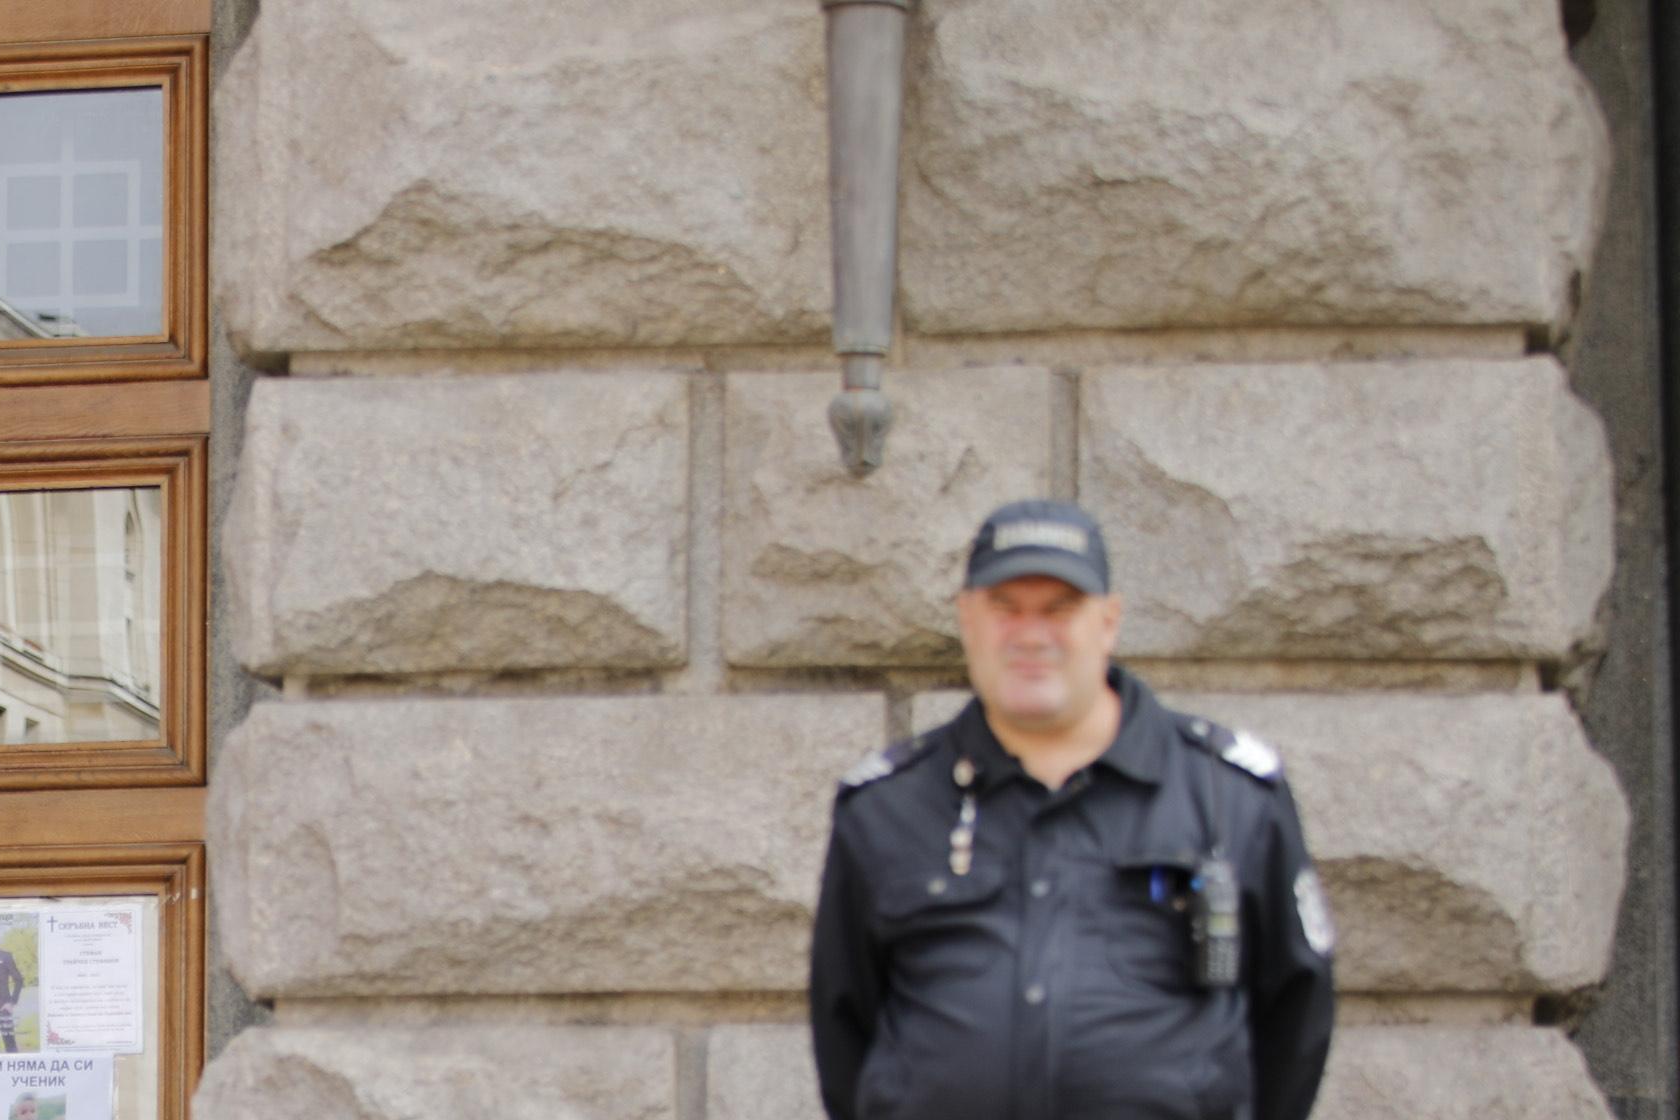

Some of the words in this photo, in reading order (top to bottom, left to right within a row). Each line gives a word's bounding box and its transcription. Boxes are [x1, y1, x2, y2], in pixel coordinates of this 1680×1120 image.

[6, 1060, 47, 1072] НЯМА
[49, 1060, 70, 1073] ДА
[73, 1059, 94, 1072] СИ
[11, 1075, 67, 1088] УЧЕНИК
